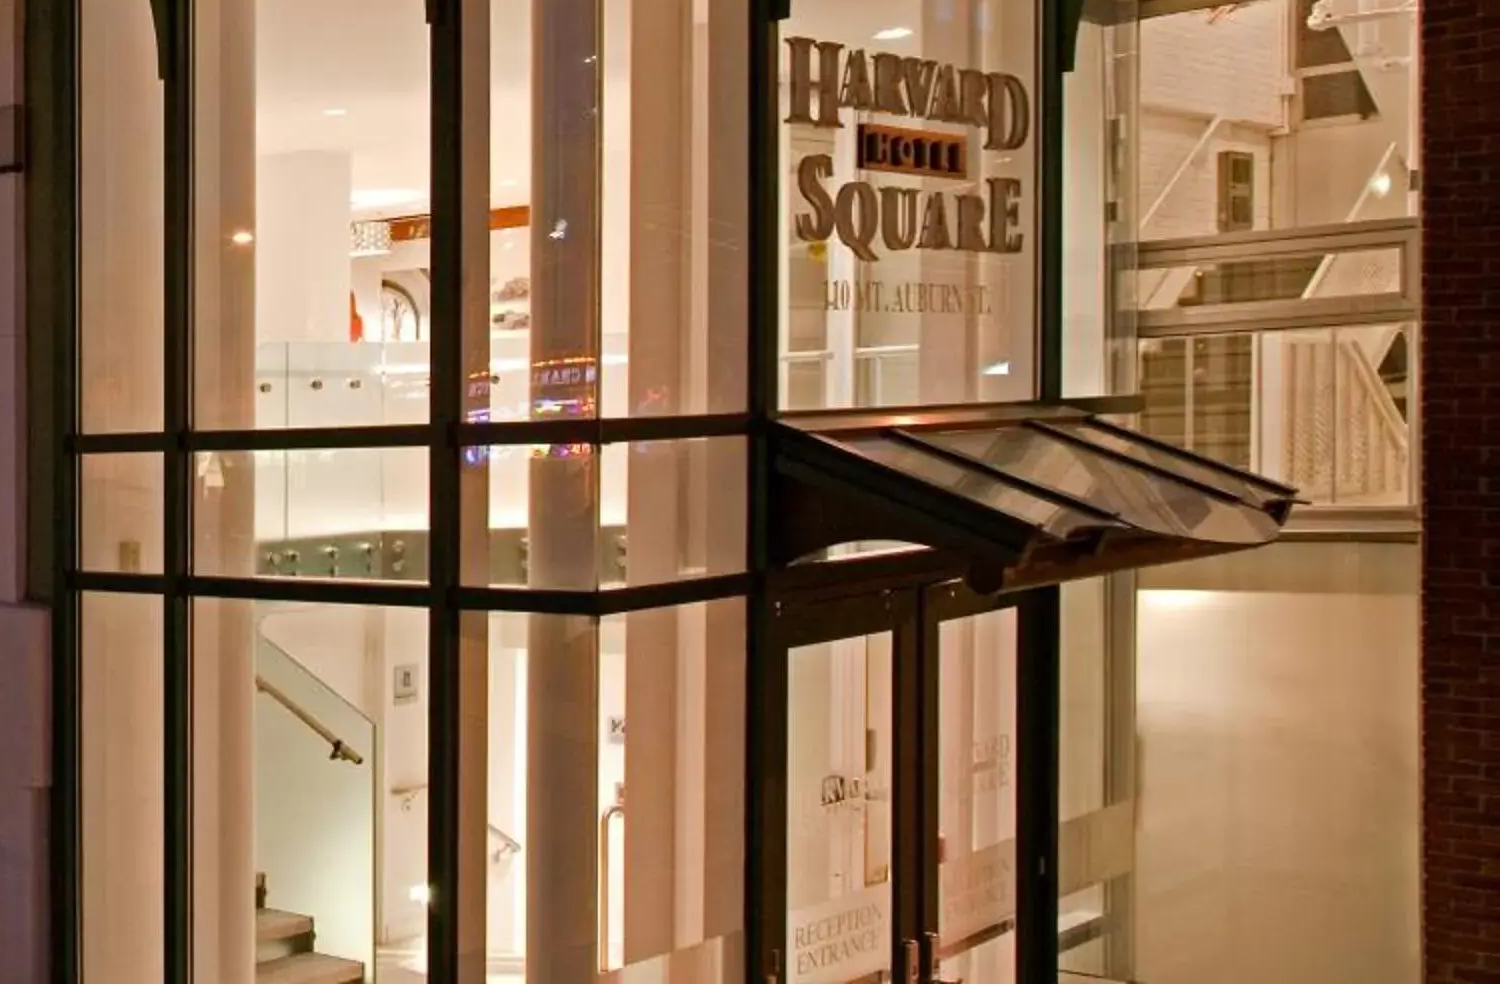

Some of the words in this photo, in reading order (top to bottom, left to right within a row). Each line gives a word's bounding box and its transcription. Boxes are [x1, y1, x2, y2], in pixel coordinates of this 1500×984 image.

[783, 36, 1030, 150] HARVARD
[794, 154, 1023, 261] SQUARE
[891, 282, 964, 314] AUBURN
[795, 903, 882, 949] RECEPTION
[797, 928, 878, 975] ENTRANCE
